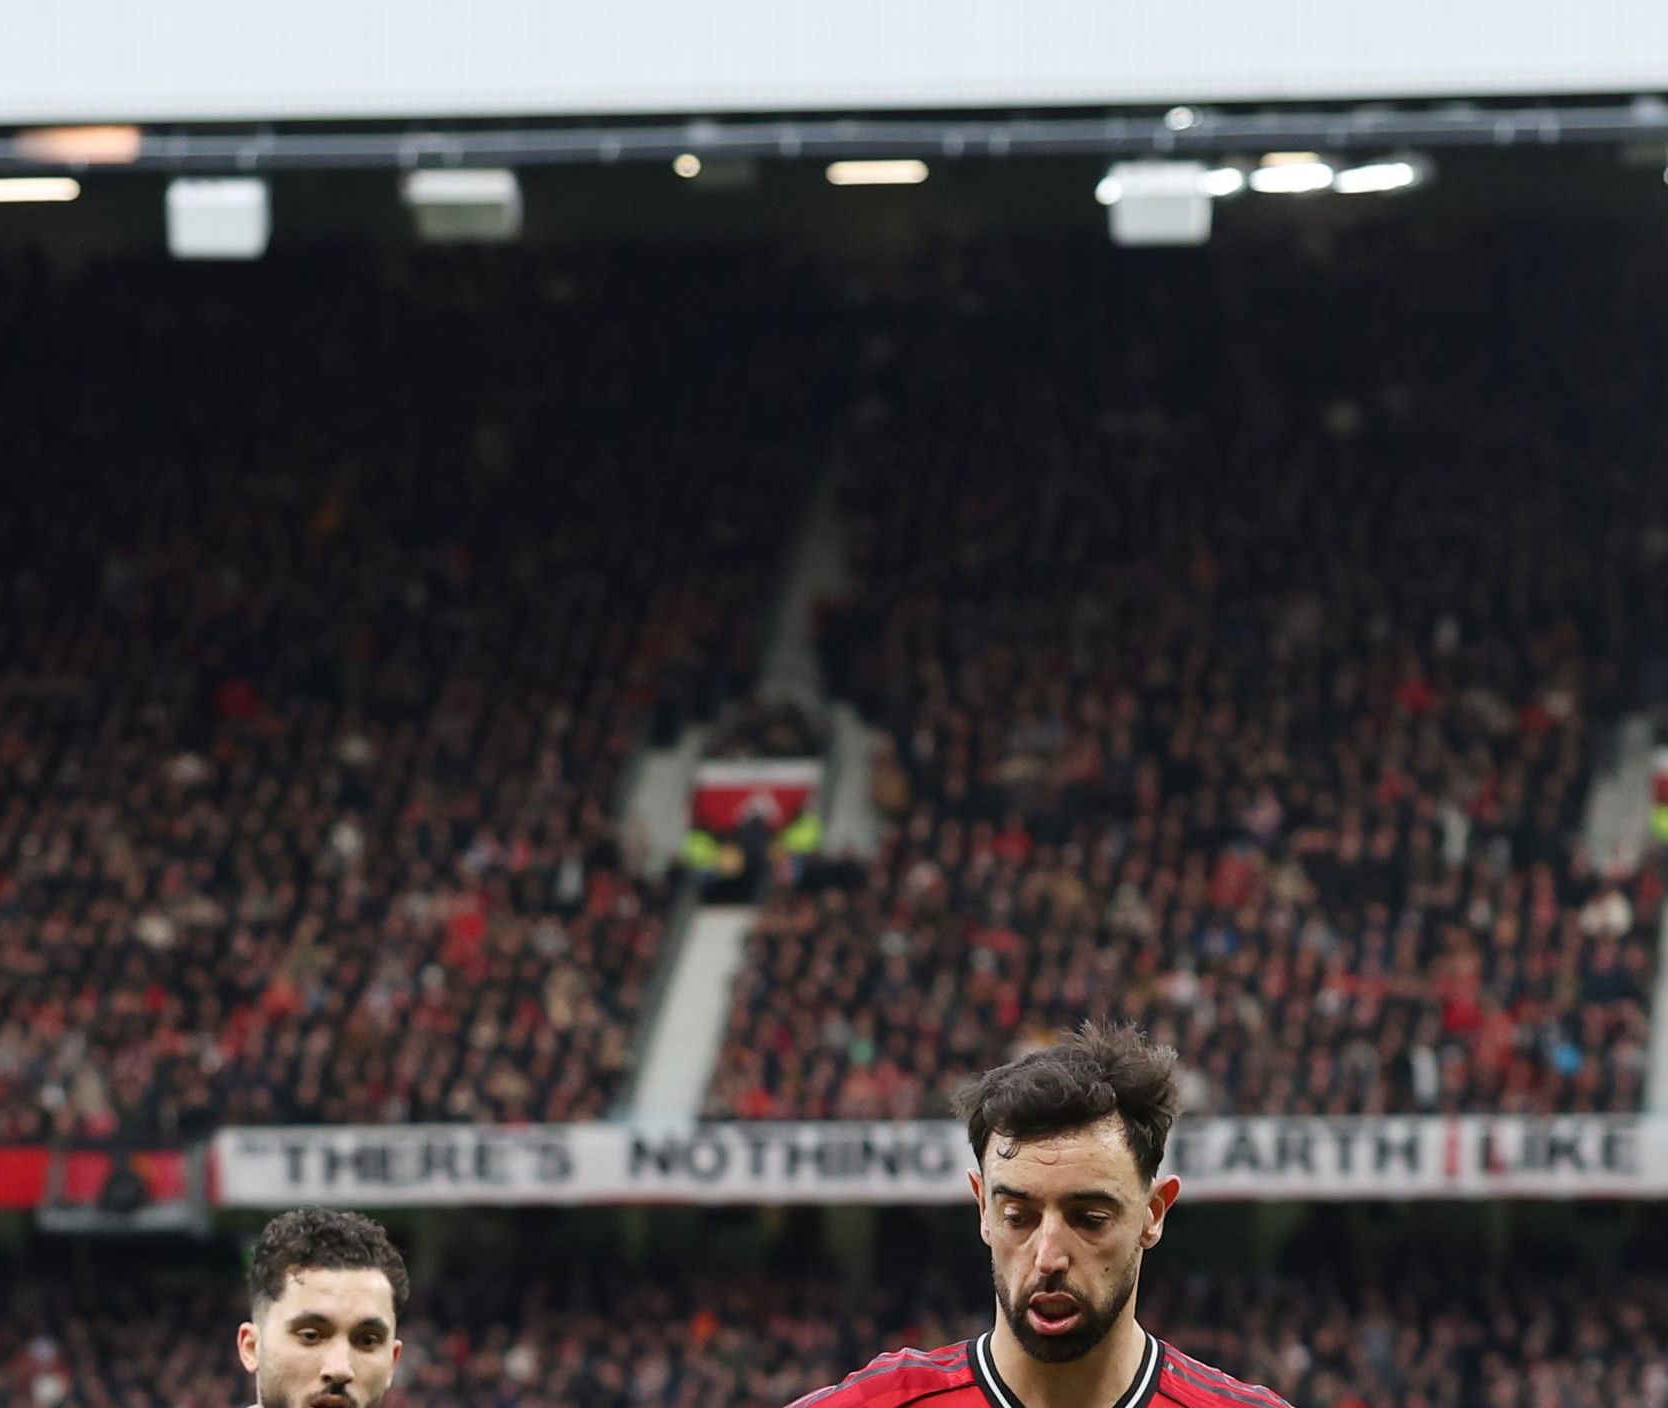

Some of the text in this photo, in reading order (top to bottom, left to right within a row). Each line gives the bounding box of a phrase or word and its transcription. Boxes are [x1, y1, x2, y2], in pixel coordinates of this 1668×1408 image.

[627, 1132, 956, 1184] NOTHING
[1172, 1126, 1420, 1177] EARTH
[1476, 1122, 1640, 1176] LIKE
